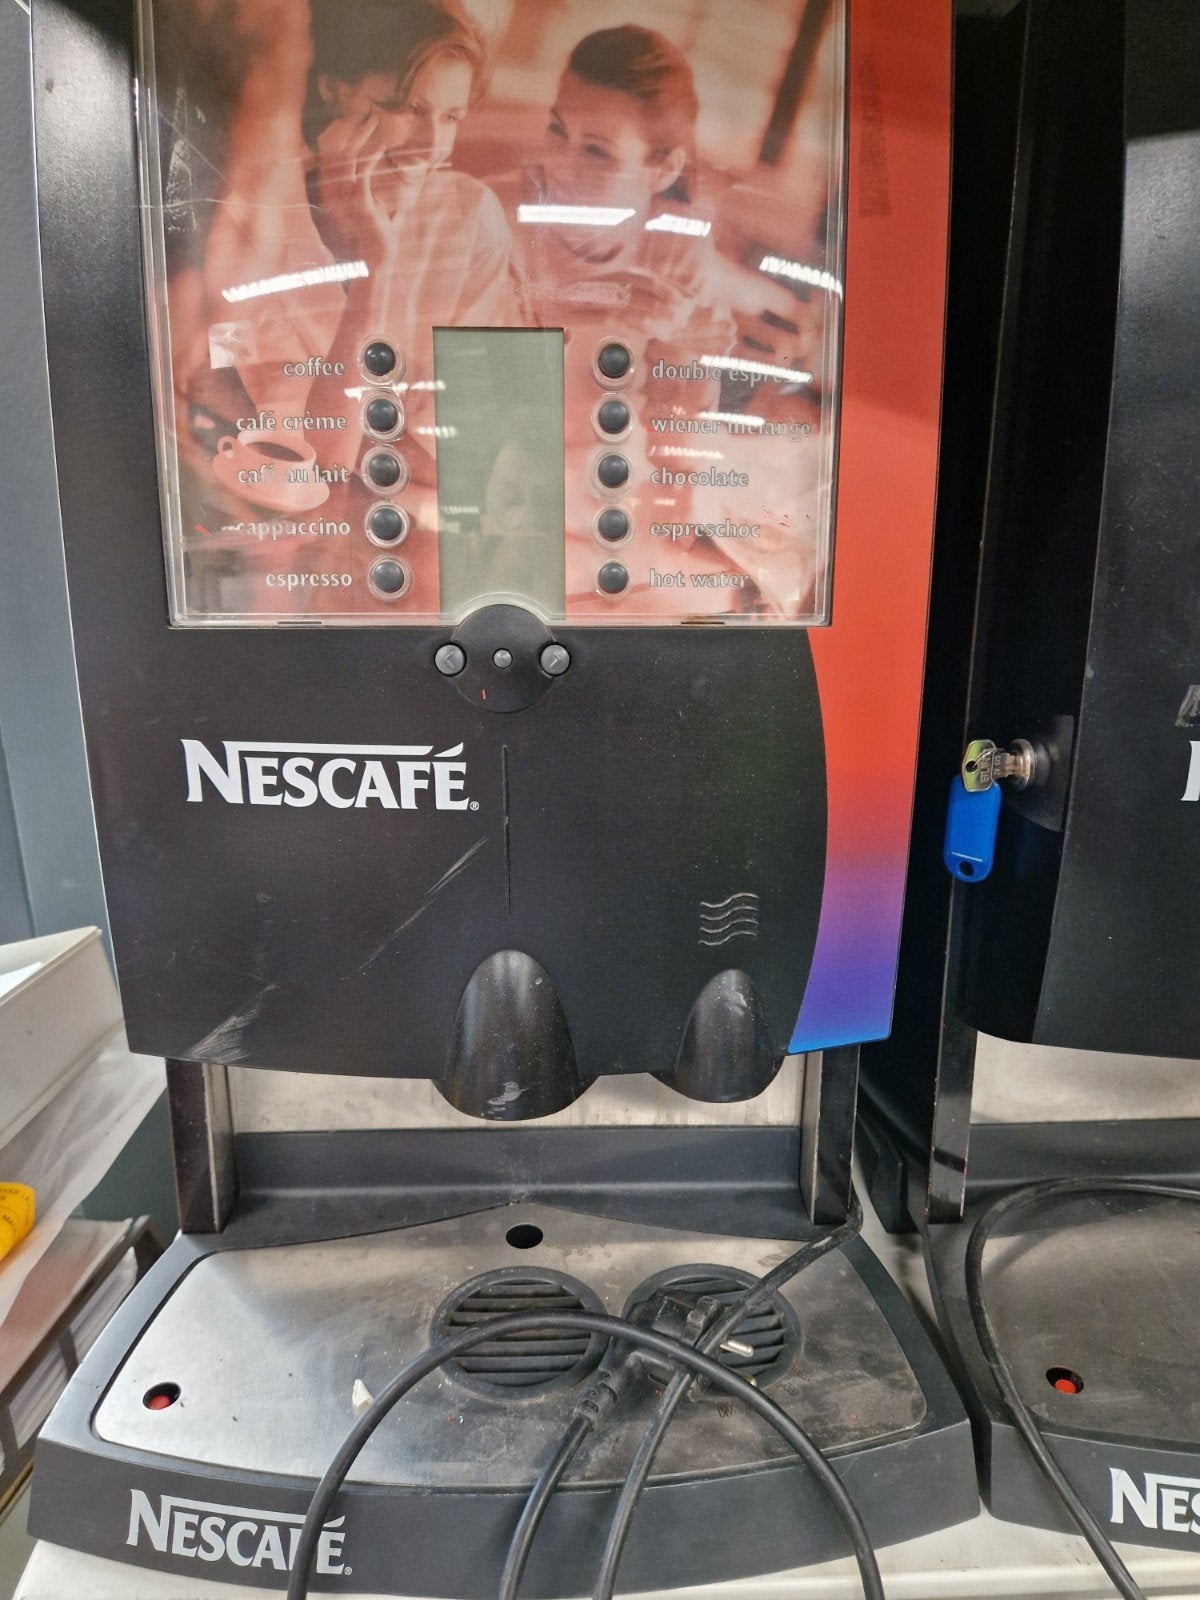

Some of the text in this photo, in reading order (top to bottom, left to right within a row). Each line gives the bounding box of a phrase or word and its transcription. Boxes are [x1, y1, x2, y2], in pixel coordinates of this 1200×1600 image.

[282, 356, 345, 376] coffee
[651, 359, 722, 380] double
[236, 410, 348, 431] café crème
[651, 414, 722, 435] wiener
[284, 467, 309, 484] au
[313, 464, 350, 485] lait
[650, 466, 750, 487] chocolate
[650, 518, 761, 542] espreschoc
[265, 571, 354, 592] espresso
[649, 568, 750, 588] hot water
